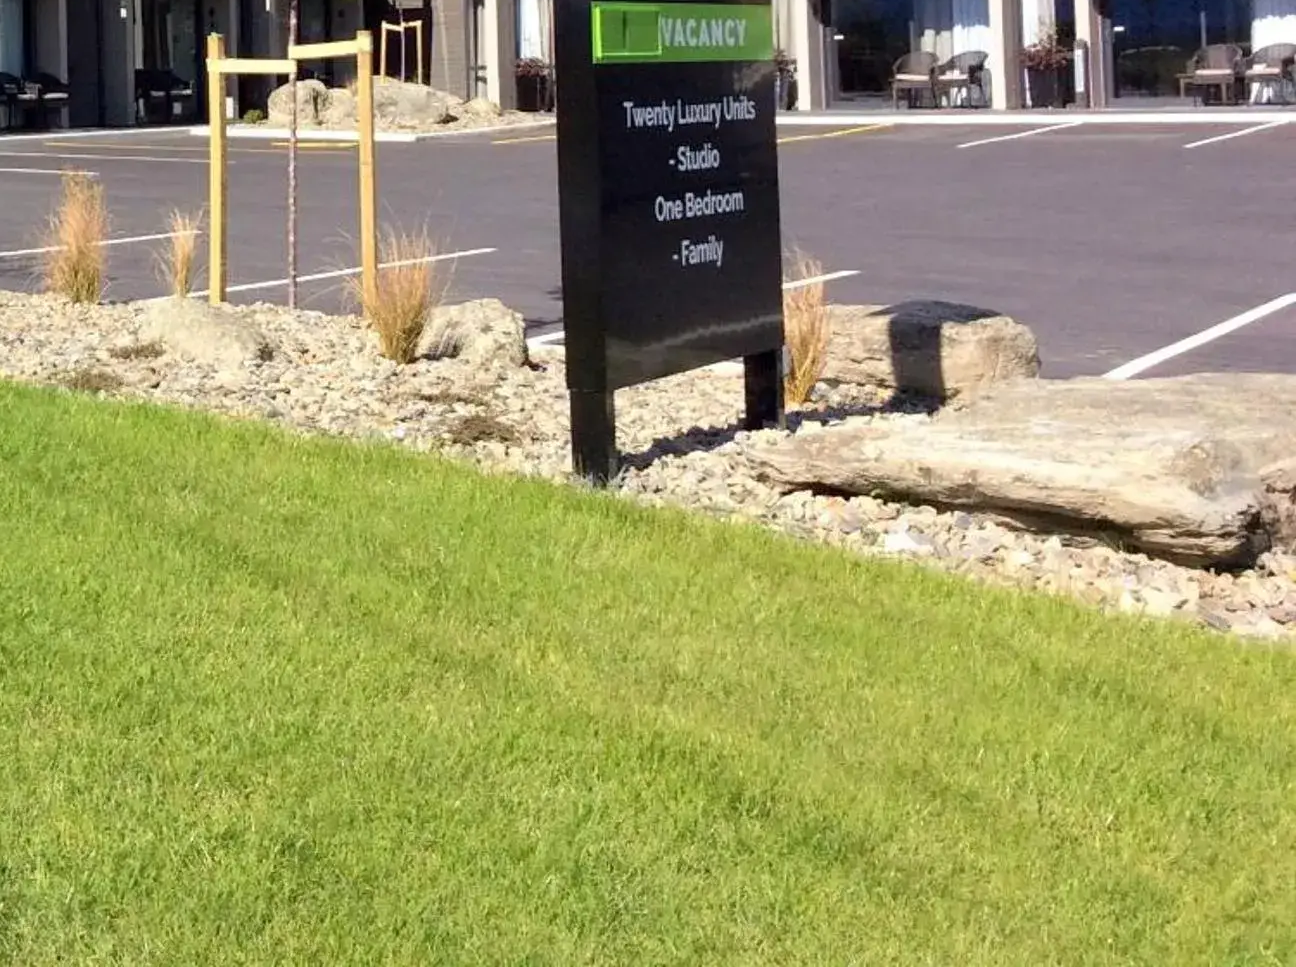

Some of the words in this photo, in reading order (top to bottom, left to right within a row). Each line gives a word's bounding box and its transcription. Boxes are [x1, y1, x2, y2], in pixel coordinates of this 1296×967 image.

[660, 15, 747, 47] VACANCY
[623, 99, 675, 132] Twenty
[677, 99, 721, 129] Luxury
[723, 95, 756, 121] Units
[655, 196, 683, 221] One
[685, 189, 744, 218] Bedroom
